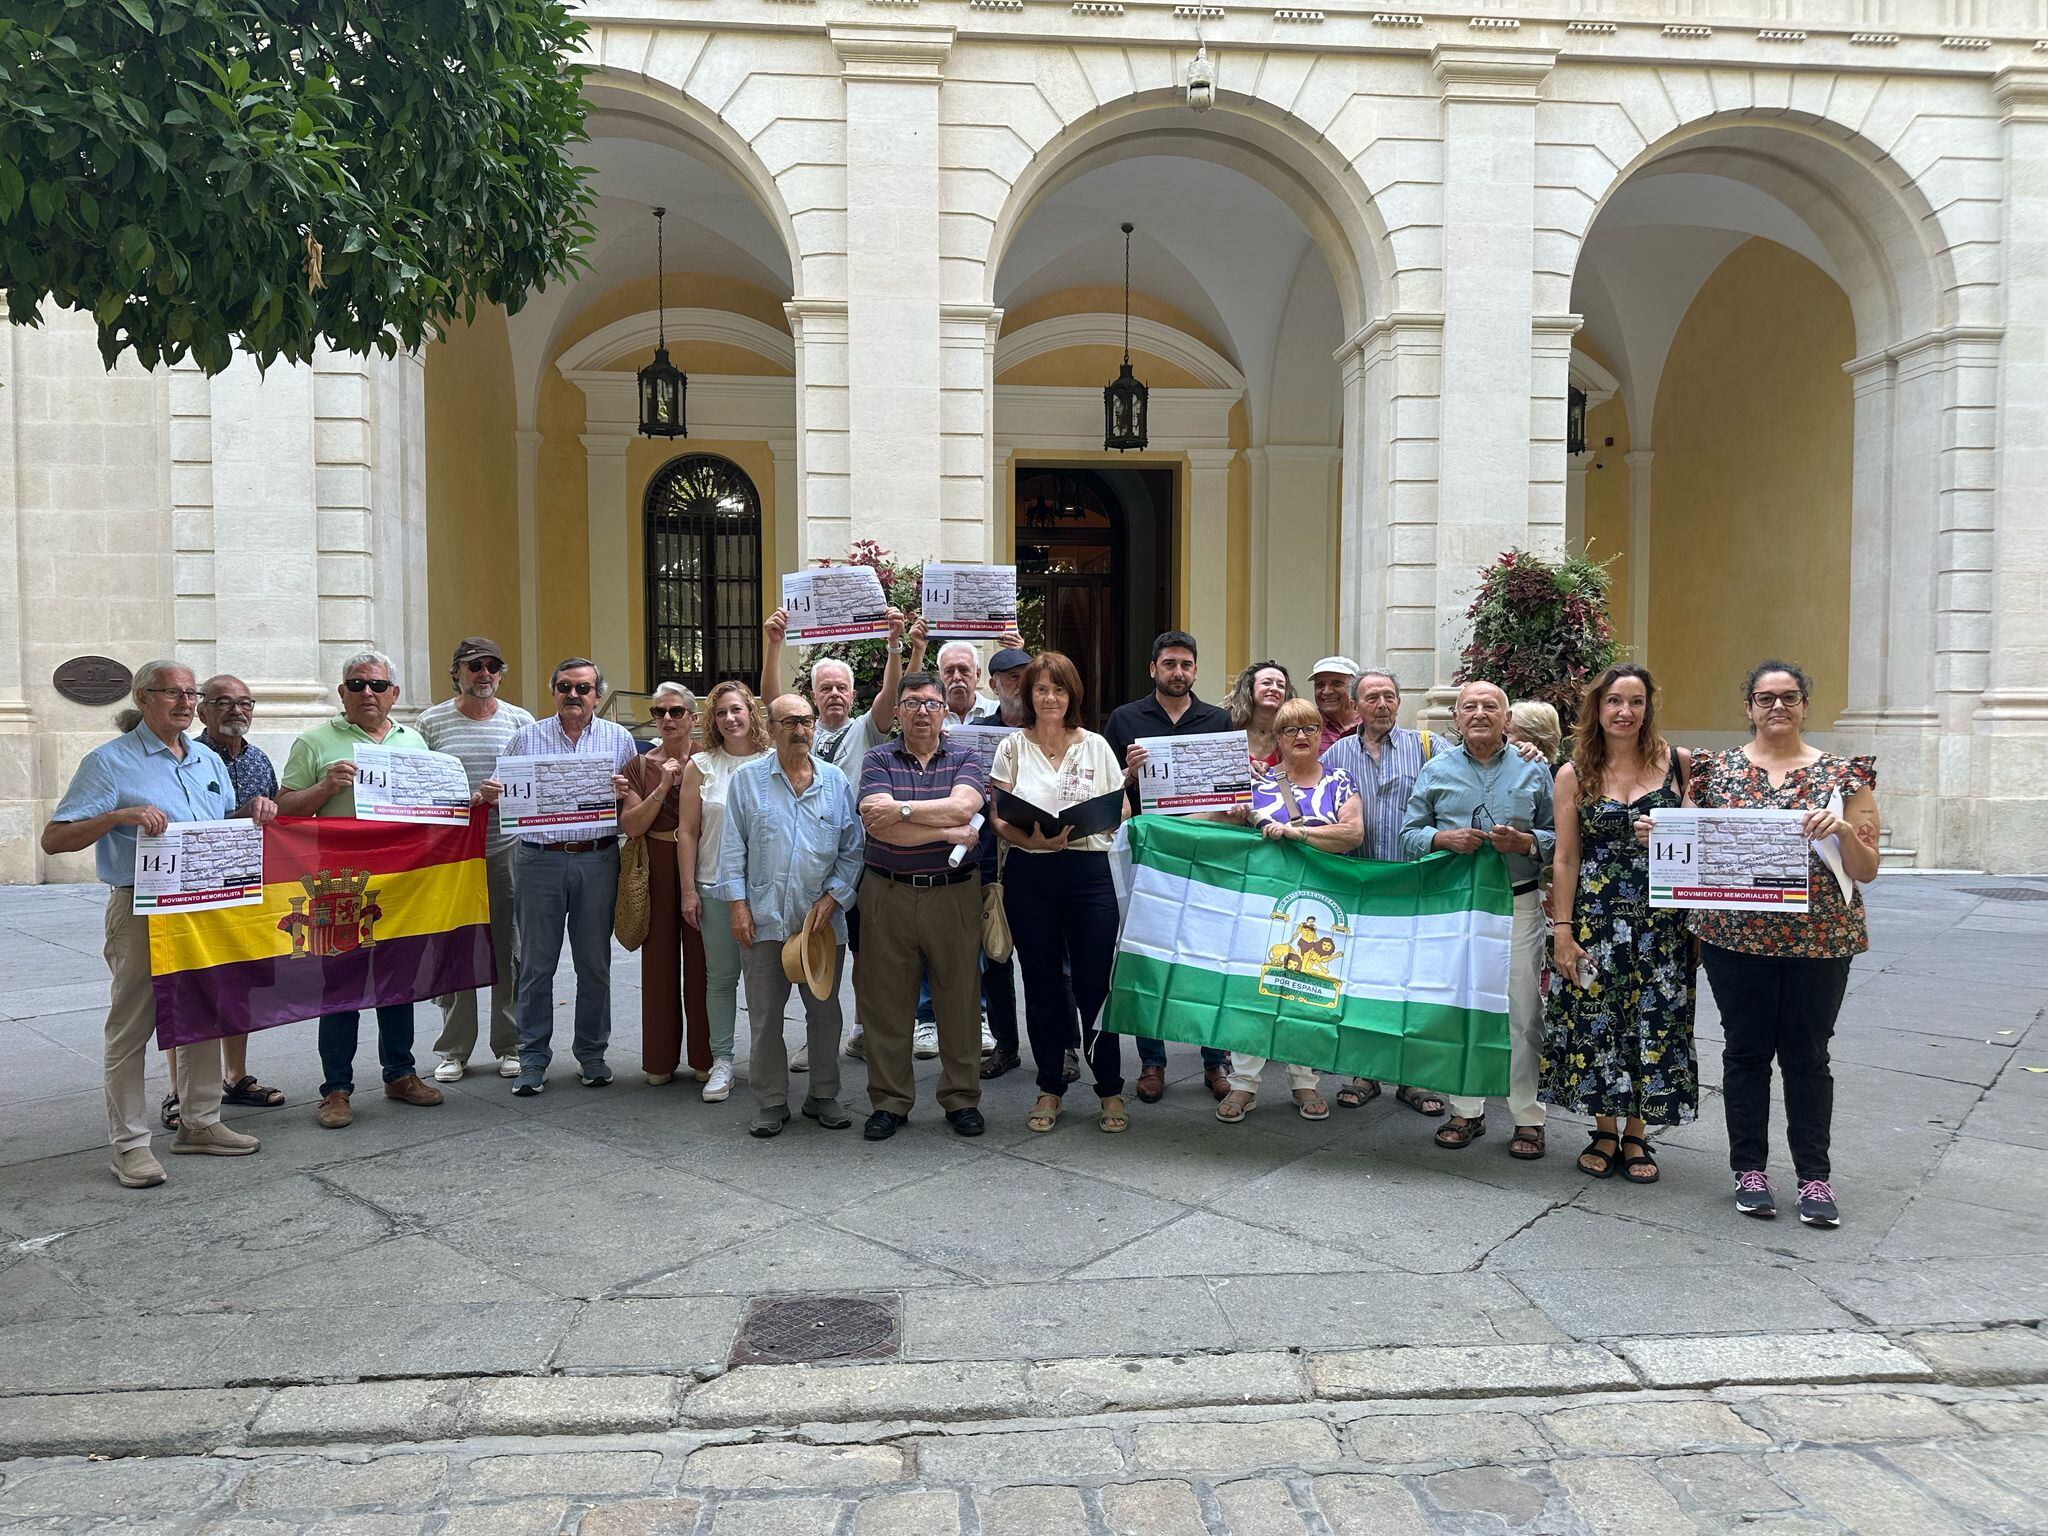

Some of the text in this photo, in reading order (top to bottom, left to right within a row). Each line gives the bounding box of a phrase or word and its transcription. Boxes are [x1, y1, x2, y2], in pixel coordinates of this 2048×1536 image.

[786, 596, 811, 613] 14-J
[926, 588, 950, 605] 14-J
[836, 626, 871, 634] MEMORIALISTA
[358, 769, 387, 788] 14-J
[1142, 761, 1169, 780] 14-J
[503, 782, 531, 799] 14-J
[1160, 798, 1194, 806] MOVIMIENTO
[377, 807, 451, 816] MOVIMIENTO MEMORIALISTA
[557, 814, 596, 822] MEMORIALISTA
[1653, 842, 1692, 865] 14-J
[141, 853, 178, 875] 14-J
[161, 891, 241, 904] MOVIMIENTO MEMORIALISTA
[1677, 890, 1779, 900] MOVIMIENTO MEMORIALISTA
[1274, 977, 1323, 995] POR ESPAÑA
